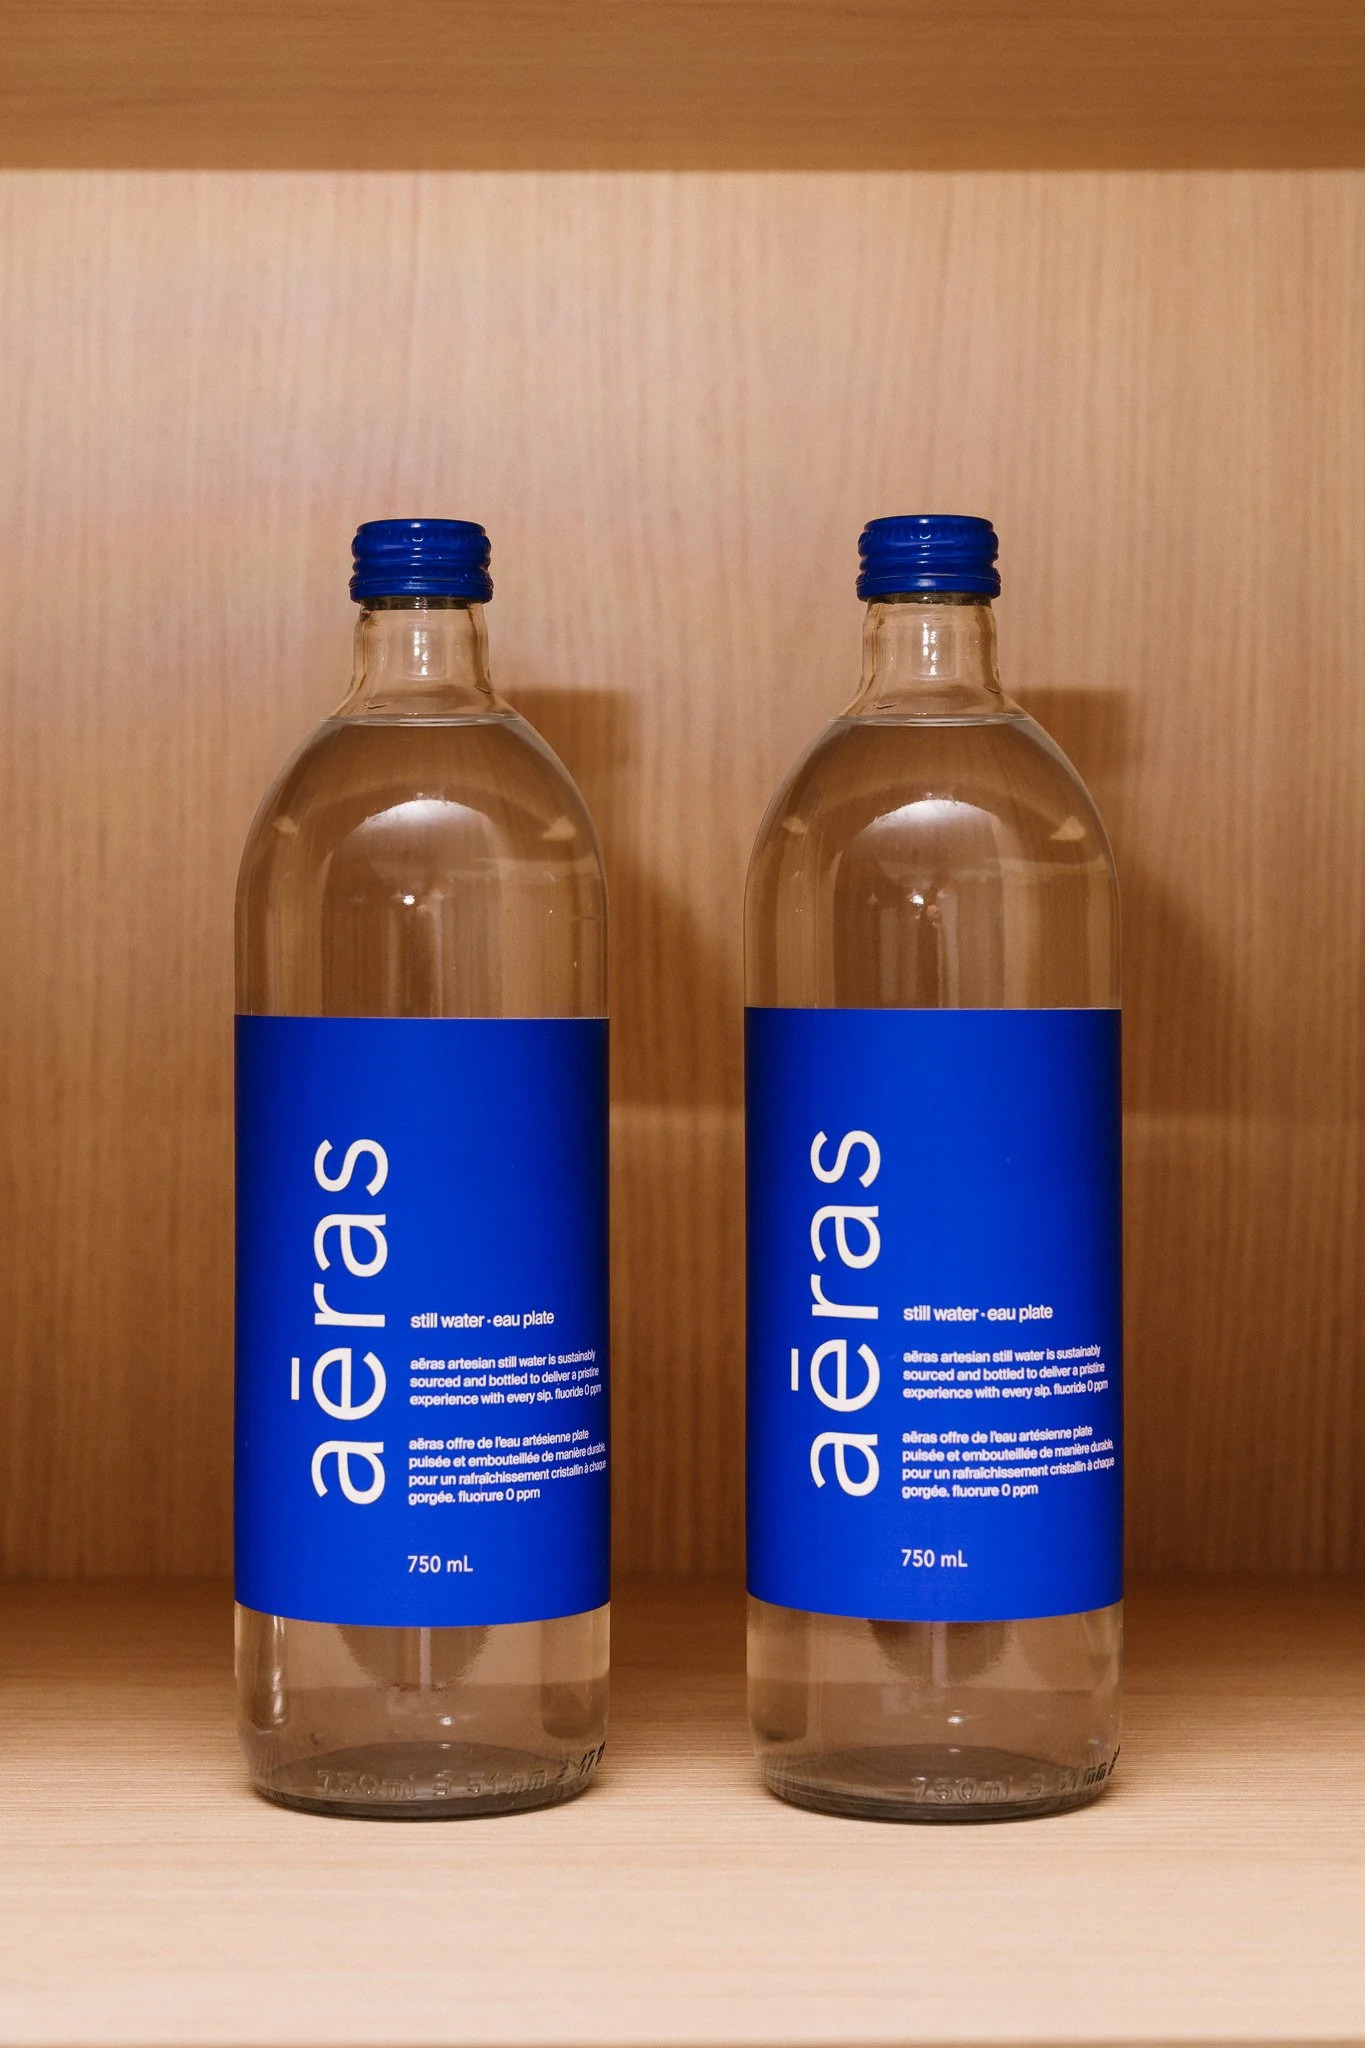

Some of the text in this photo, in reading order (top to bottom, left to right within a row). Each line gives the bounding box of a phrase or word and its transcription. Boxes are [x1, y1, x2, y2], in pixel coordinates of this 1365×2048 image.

[291, 1139, 388, 1504] aēras
[411, 1310, 554, 1328] still water eau plate
[791, 1131, 880, 1496] aēras
[904, 1304, 1053, 1323] still water eau plate
[448, 1357, 495, 1369] artesian
[498, 1356, 517, 1368] still
[519, 1356, 546, 1367] water
[549, 1354, 556, 1365] is
[558, 1350, 595, 1364] sustainably
[940, 1351, 990, 1363] artesian
[992, 1350, 1012, 1362] still
[1014, 1350, 1044, 1361] water
[1047, 1348, 1055, 1360] is
[1057, 1345, 1100, 1359] sustainably
[410, 1368, 599, 1387] sourced and bottled to deliver a pristine
[903, 1362, 1105, 1381] sourced and bottled to deliver a pristine
[410, 1393, 478, 1407] experience
[481, 1392, 504, 1404] with
[507, 1393, 535, 1404] every
[537, 1389, 553, 1402] sip.
[555, 1386, 583, 1399] fluoride
[590, 1385, 601, 1396] ppm
[903, 1387, 973, 1400] experience
[975, 1386, 1000, 1398] with
[1002, 1387, 1032, 1399] every
[1034, 1385, 1052, 1398] sip.
[1054, 1382, 1086, 1395] fluoride
[1094, 1380, 1108, 1393] ppm
[446, 1437, 475, 1449] offre
[477, 1437, 493, 1449] de
[522, 1433, 570, 1446] artésienne
[572, 1429, 589, 1443] plate
[940, 1431, 969, 1444] offre
[971, 1431, 988, 1444] de
[1019, 1429, 1072, 1442] artésienne
[1073, 1426, 1093, 1440] plate
[409, 1455, 451, 1470] puisée
[453, 1456, 466, 1467] et
[468, 1452, 540, 1467] embouteillée
[542, 1451, 554, 1462] de
[556, 1447, 586, 1460] manière
[903, 1449, 945, 1463] puisée
[947, 1450, 960, 1462] et
[963, 1447, 1038, 1461] embouteillée
[1040, 1446, 1053, 1458] de
[1055, 1443, 1090, 1457] manière
[409, 1460, 606, 1487] pour un rafraîchissement cristallin à chaque
[902, 1457, 1114, 1481] pour un rafraîchissement cristallin à chaque
[408, 1491, 456, 1505] gorgée.
[458, 1490, 503, 1502] fluorure
[517, 1489, 540, 1502] ppm
[902, 1485, 950, 1500] gorgée.
[952, 1485, 999, 1496] fluorure
[1013, 1485, 1038, 1498] ppm
[408, 1555, 473, 1573] 750 mL
[902, 1549, 968, 1567] 750 mL
